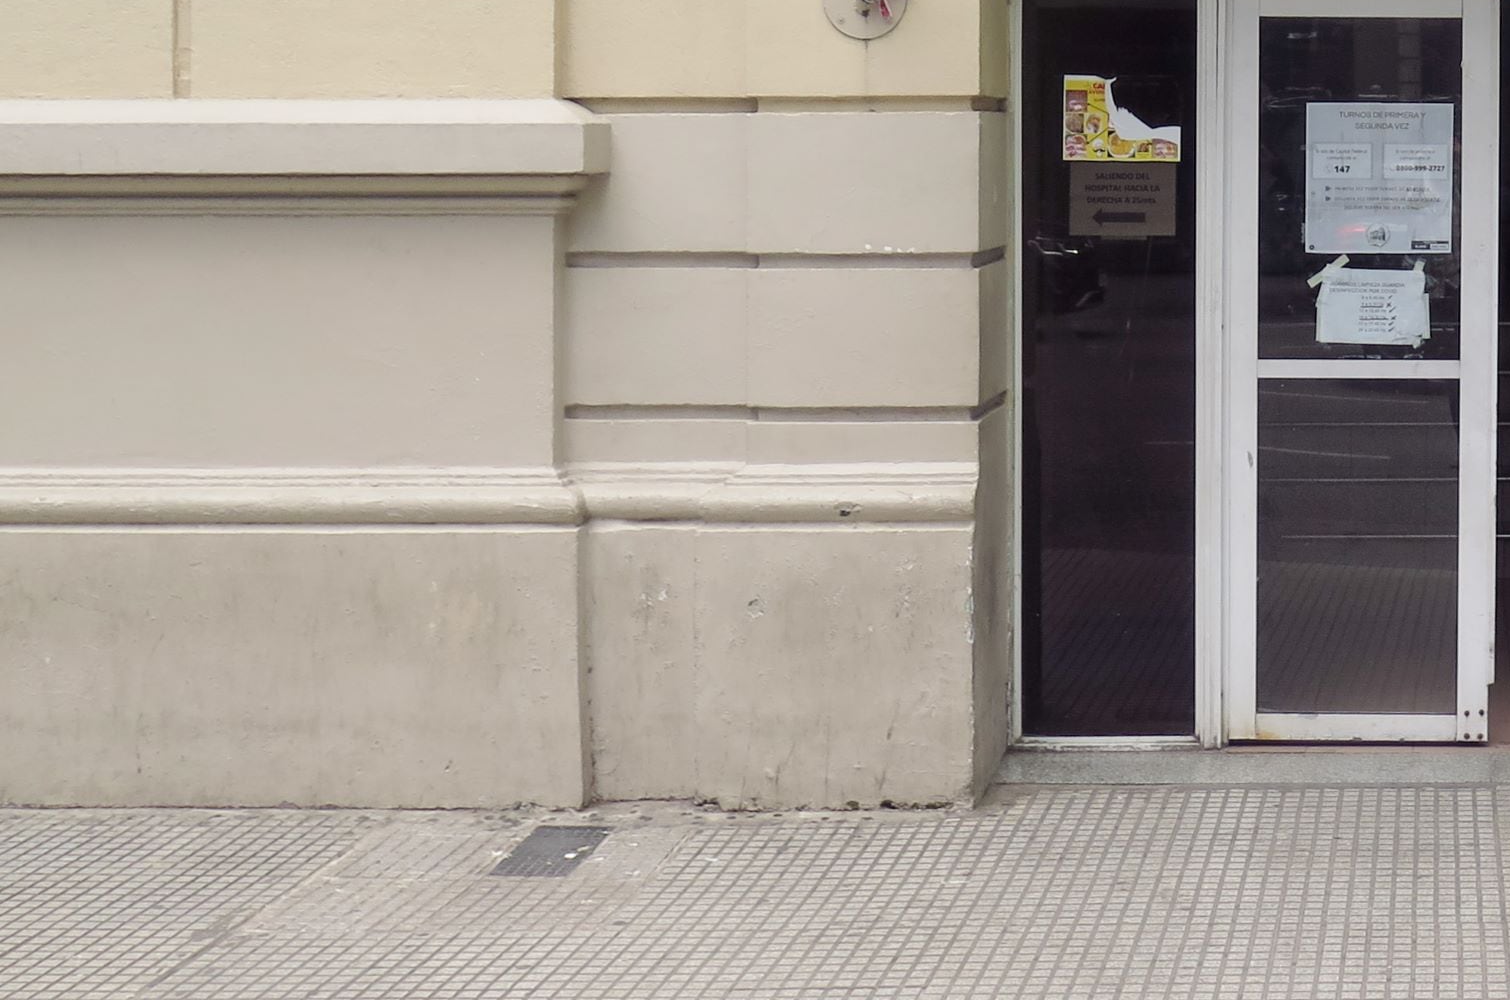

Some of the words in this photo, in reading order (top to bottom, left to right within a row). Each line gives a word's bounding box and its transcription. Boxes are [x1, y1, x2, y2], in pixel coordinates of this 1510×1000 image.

[1340, 111, 1372, 119] TURNOS
[1355, 122, 1393, 130] SEGUNDA
[1334, 165, 1350, 173] 147
[1085, 184, 1122, 192] HOSPITAL
